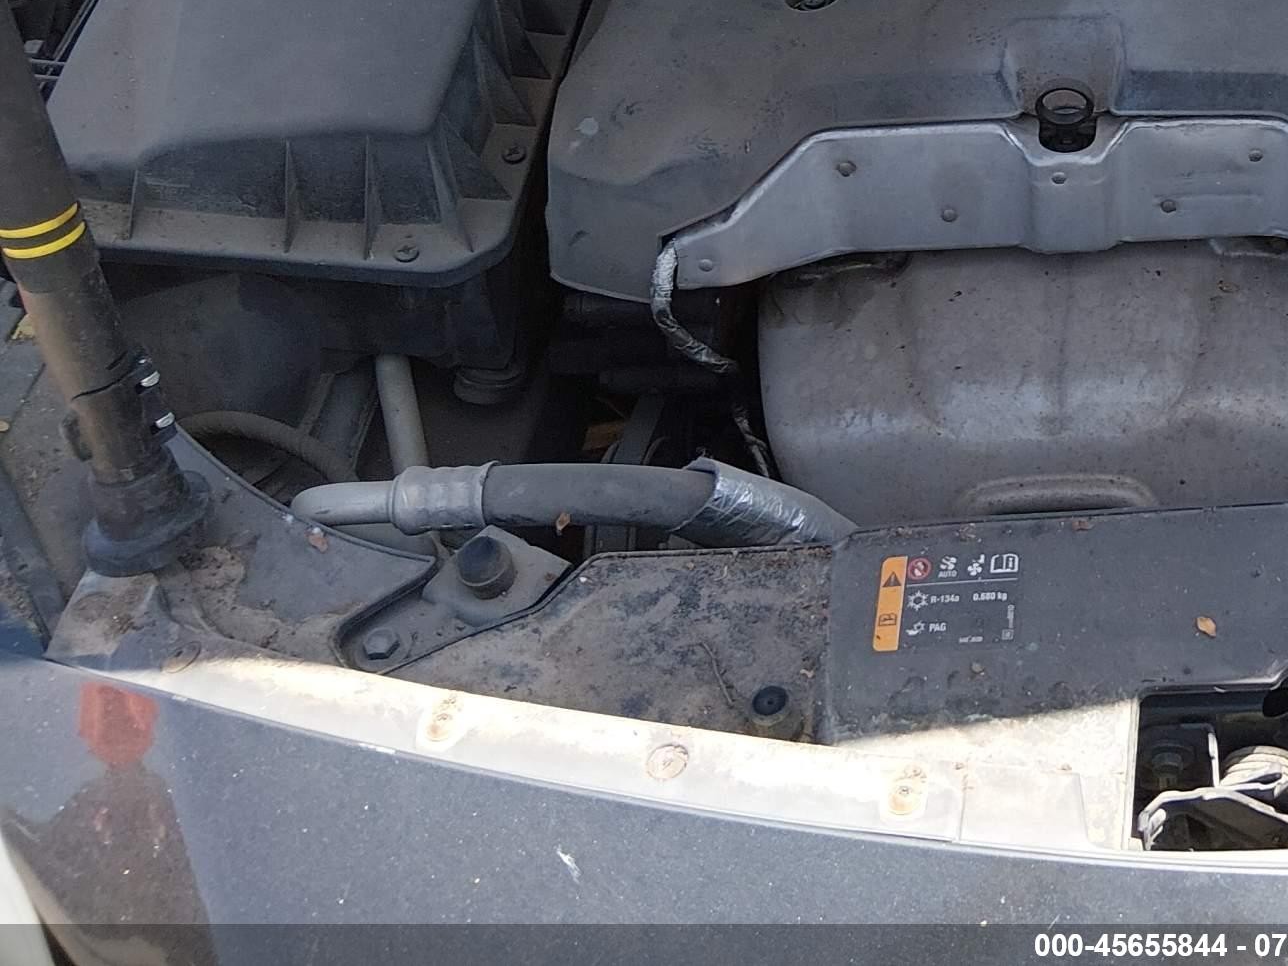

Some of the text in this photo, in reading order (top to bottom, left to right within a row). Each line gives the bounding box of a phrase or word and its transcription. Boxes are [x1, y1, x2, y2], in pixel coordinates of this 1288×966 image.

[938, 570, 957, 578] AUTO
[930, 594, 960, 603] R-134a
[997, 591, 1008, 601] kg
[929, 622, 947, 632] PAG
